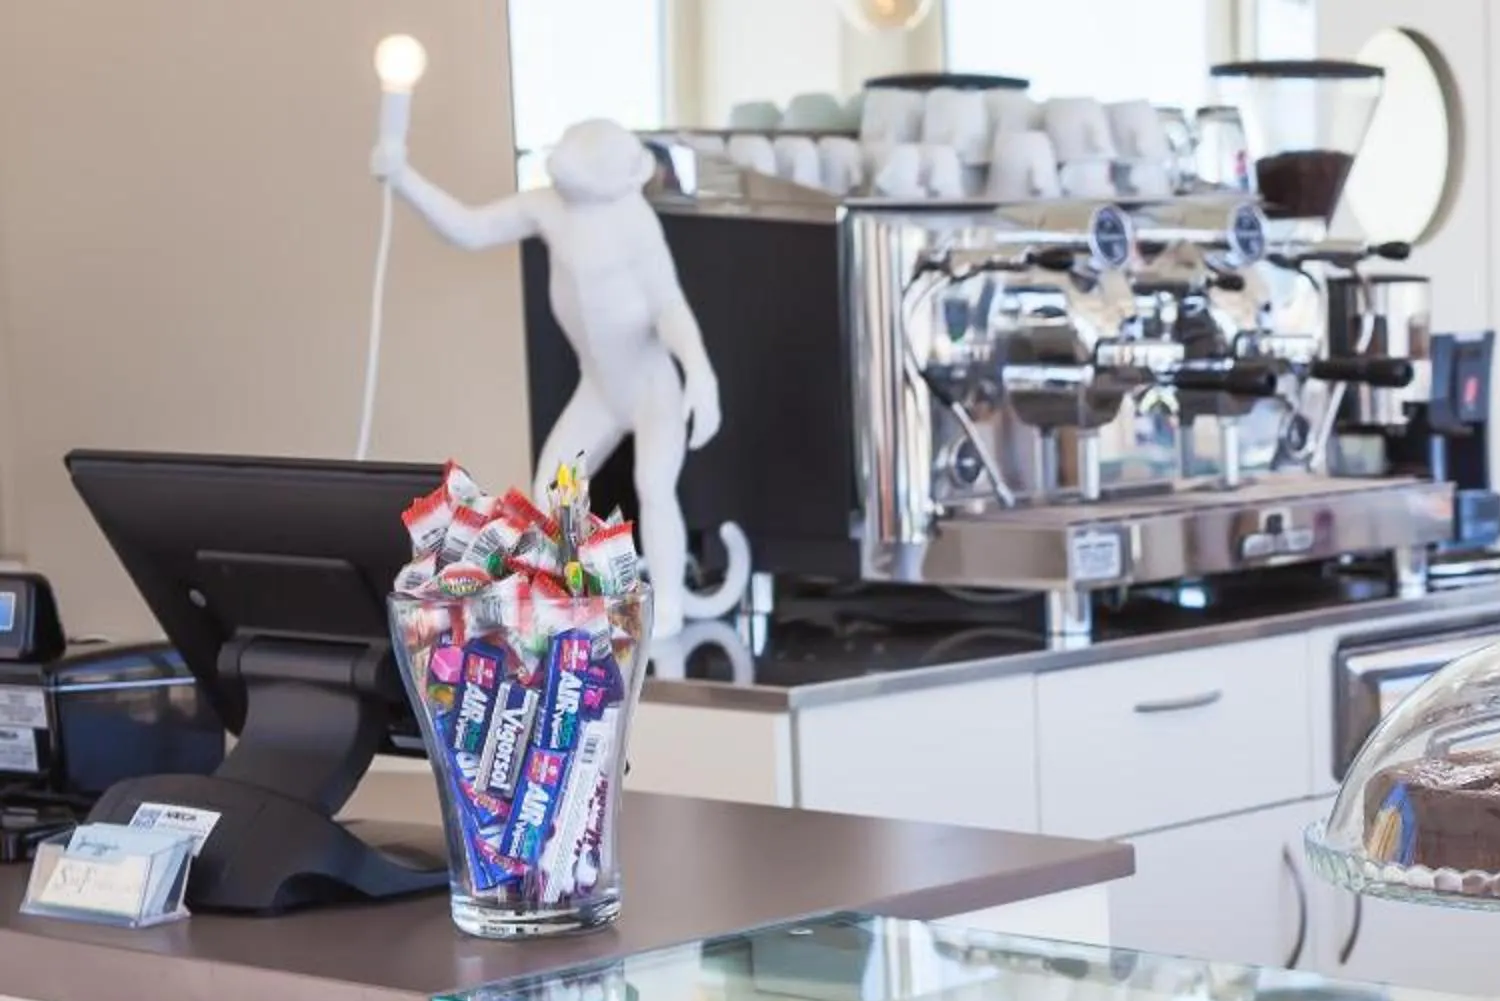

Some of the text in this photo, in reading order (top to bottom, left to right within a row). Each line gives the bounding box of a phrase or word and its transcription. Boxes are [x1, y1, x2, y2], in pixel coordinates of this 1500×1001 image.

[461, 682, 488, 723] AIR
[556, 669, 583, 714] AIR
[490, 701, 527, 790] Vigorsol
[519, 782, 549, 826] AIR
